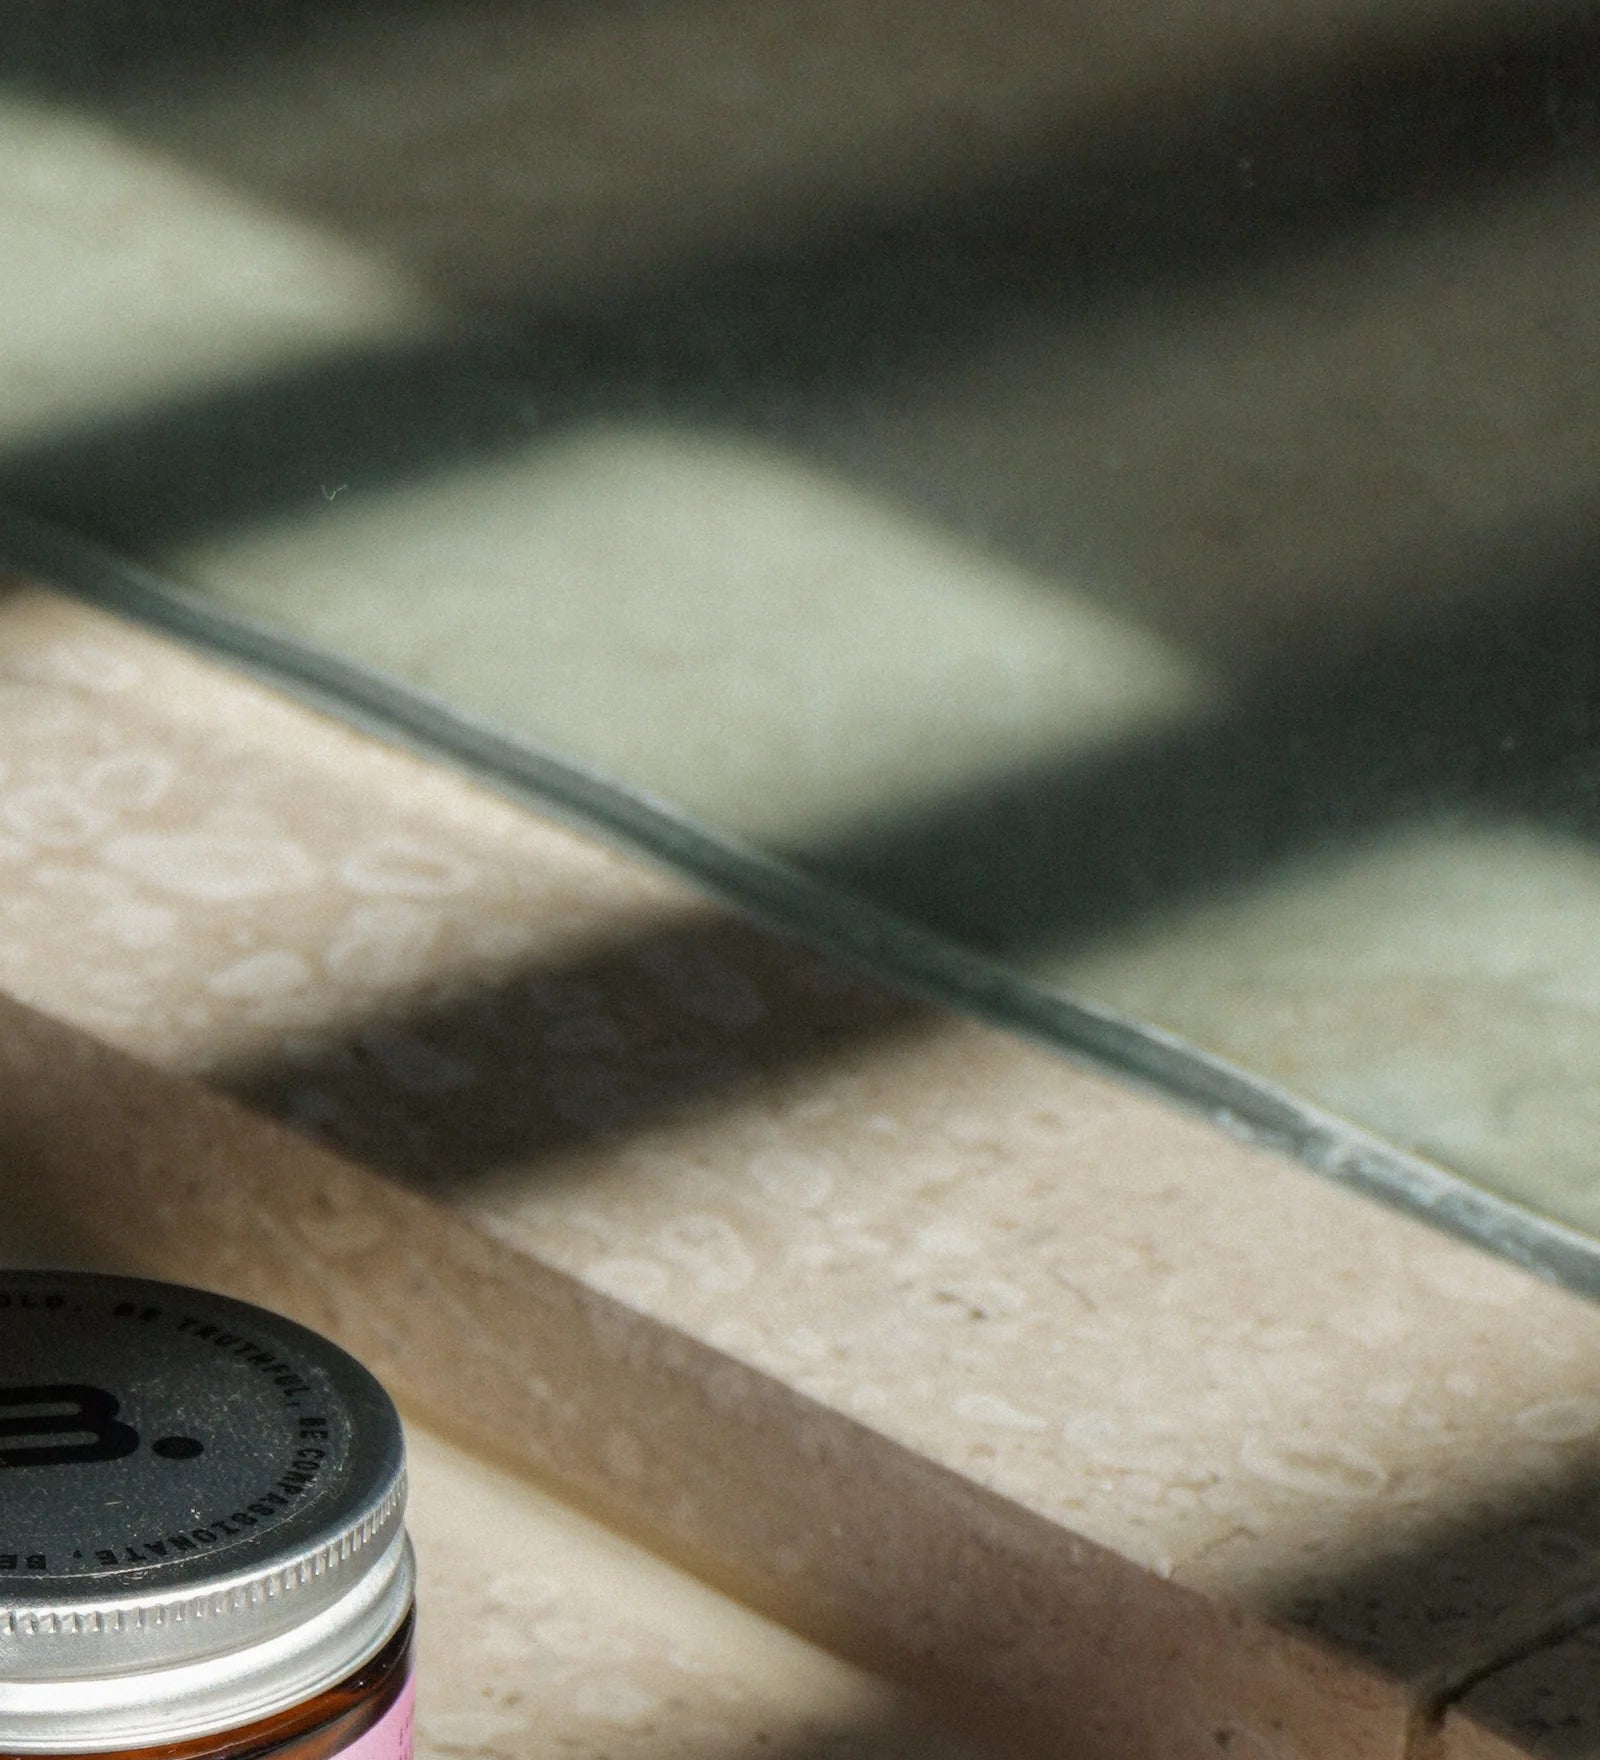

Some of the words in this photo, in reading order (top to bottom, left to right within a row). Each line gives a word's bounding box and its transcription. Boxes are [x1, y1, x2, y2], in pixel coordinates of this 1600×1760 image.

[113, 1302, 162, 1322] BE
[298, 1416, 329, 1440] BE
[71, 1448, 327, 1565] COMPASSIONATE,
